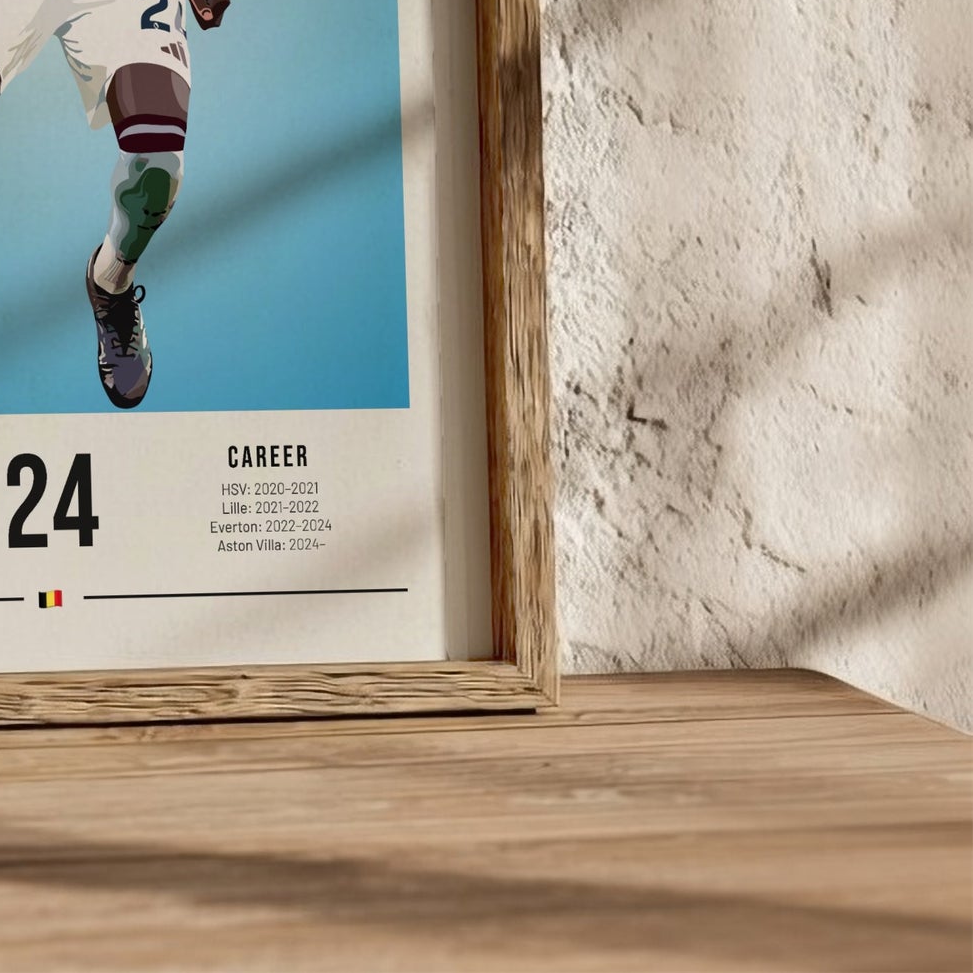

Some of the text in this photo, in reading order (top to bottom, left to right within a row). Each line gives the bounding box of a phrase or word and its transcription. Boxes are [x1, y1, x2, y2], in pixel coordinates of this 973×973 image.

[227, 444, 308, 468] CAREER
[221, 481, 319, 496] HSV: 2020-2021
[6, 453, 99, 549] 24
[222, 500, 320, 514] Lille: 2021-2022
[210, 518, 332, 533] Everton: 2022-2024
[218, 537, 326, 552] Aston Villa: 2024-
